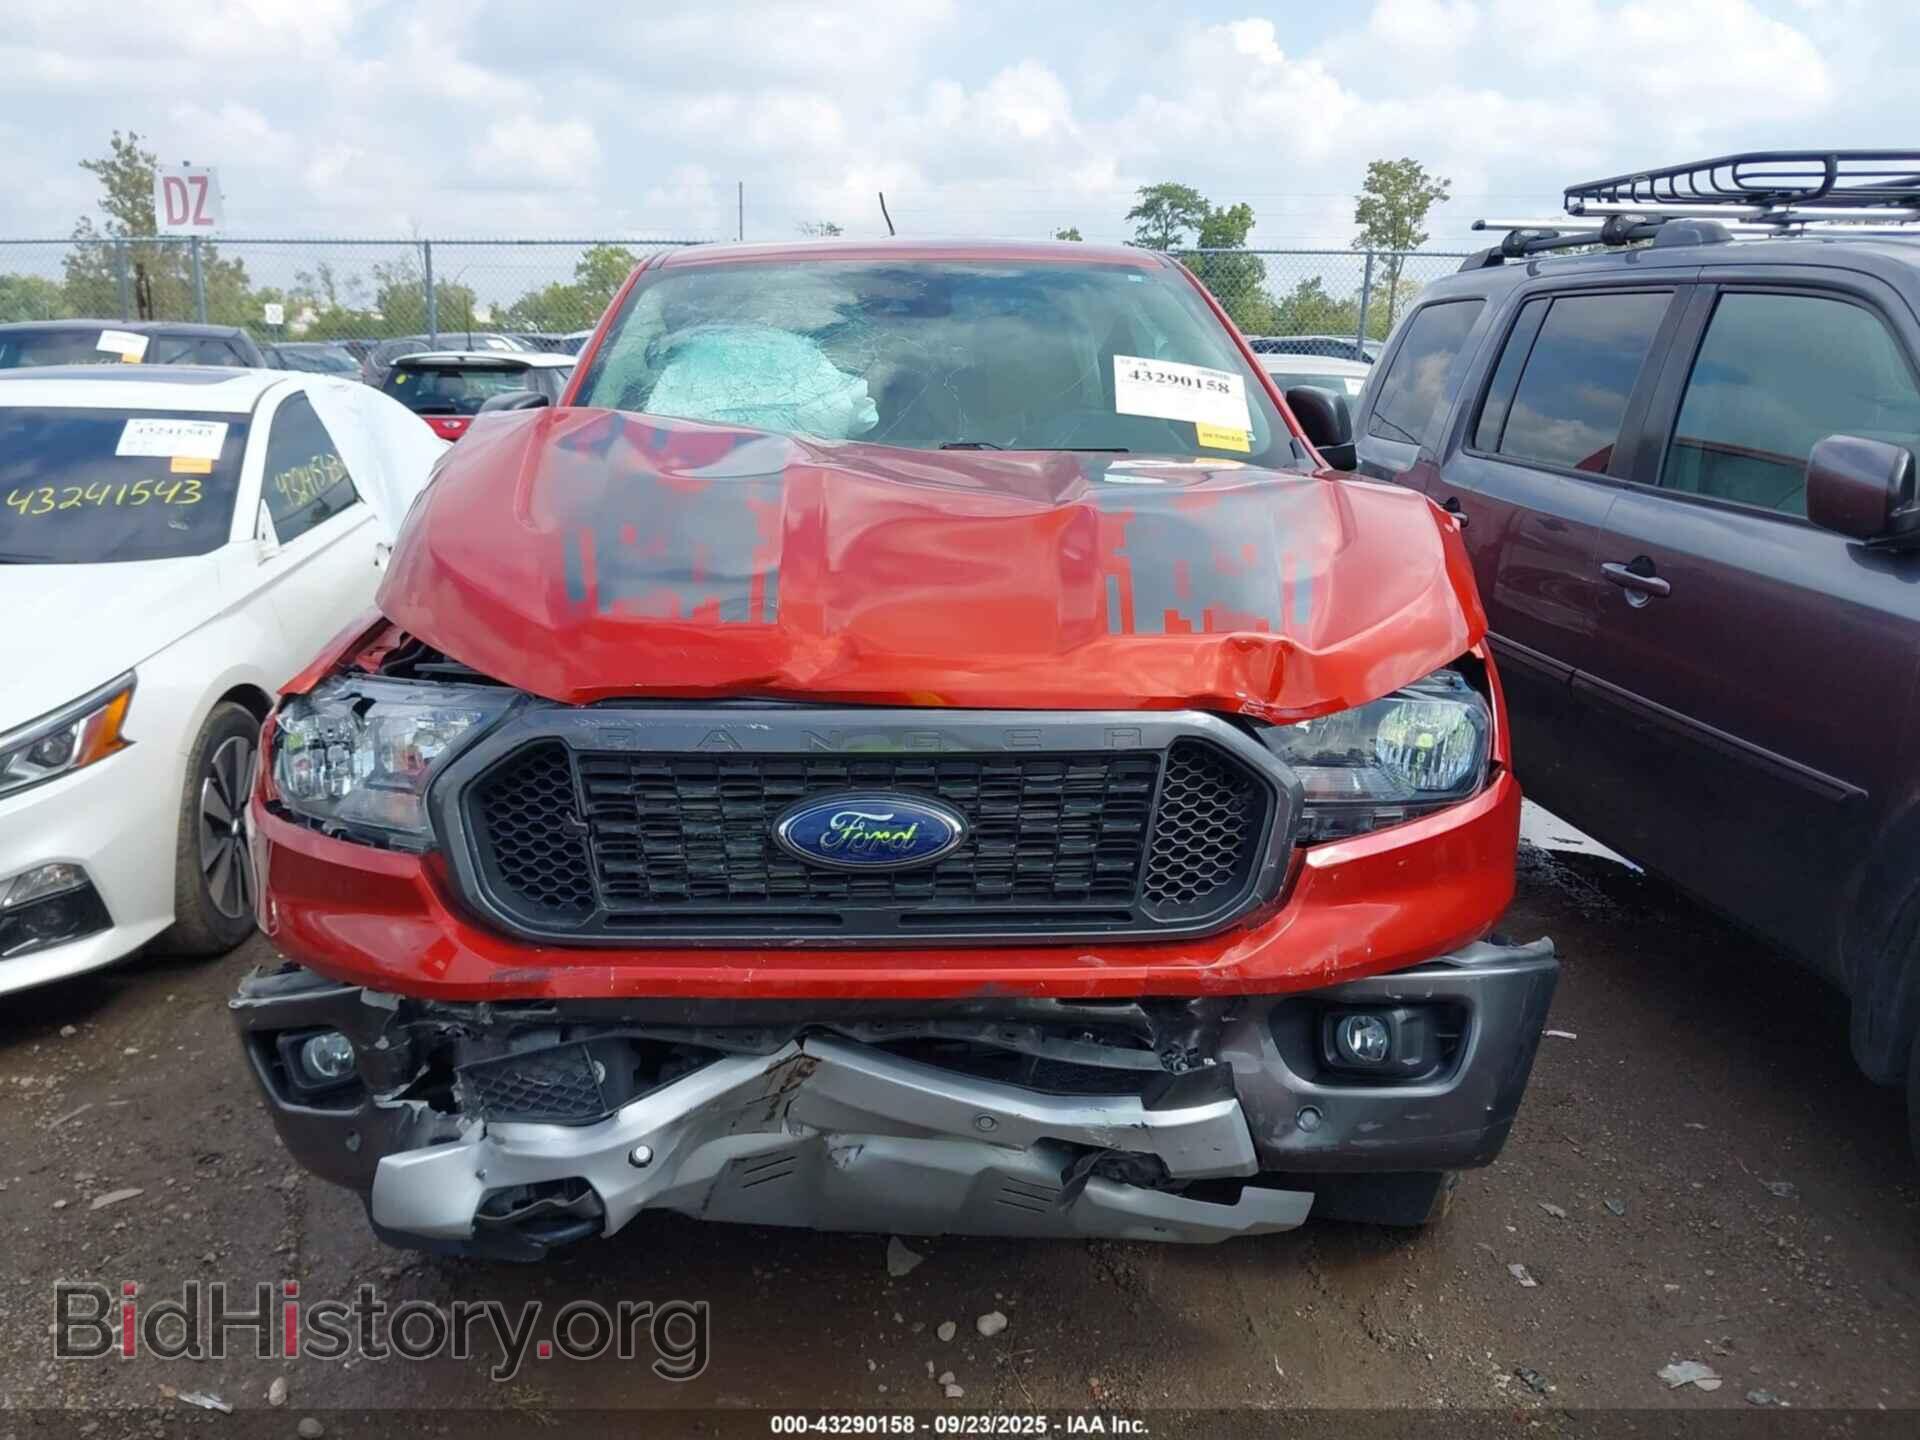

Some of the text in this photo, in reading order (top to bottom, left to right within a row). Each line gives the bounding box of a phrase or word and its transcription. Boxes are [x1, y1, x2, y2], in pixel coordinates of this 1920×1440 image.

[163, 175, 214, 226] DZ
[1129, 369, 1230, 394] 43290158
[6, 479, 202, 515] 43241543
[598, 726, 1143, 752] RANGER
[819, 811, 918, 851] Ford
